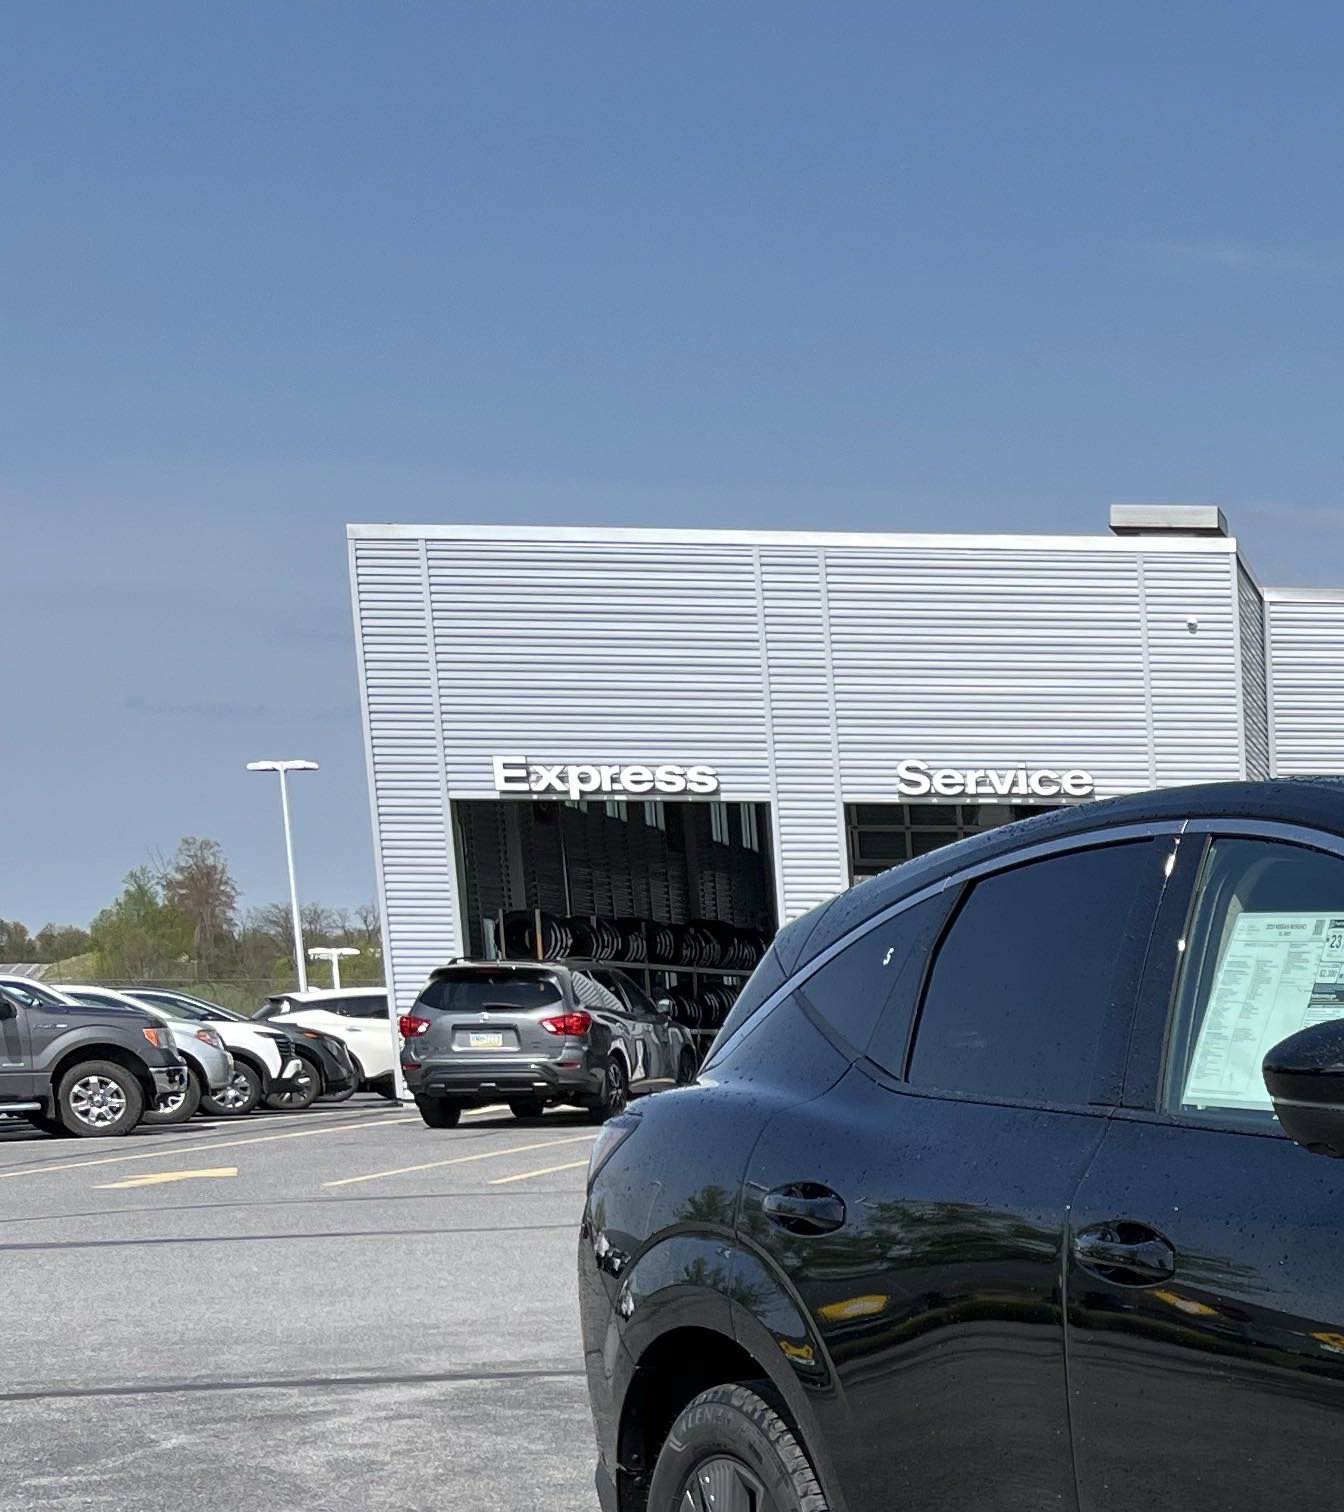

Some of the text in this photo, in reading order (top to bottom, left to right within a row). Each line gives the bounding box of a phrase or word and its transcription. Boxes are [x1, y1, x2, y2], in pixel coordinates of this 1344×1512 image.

[492, 756, 719, 800] Express
[896, 759, 1094, 796] Service
[1329, 934, 1343, 949] 23
